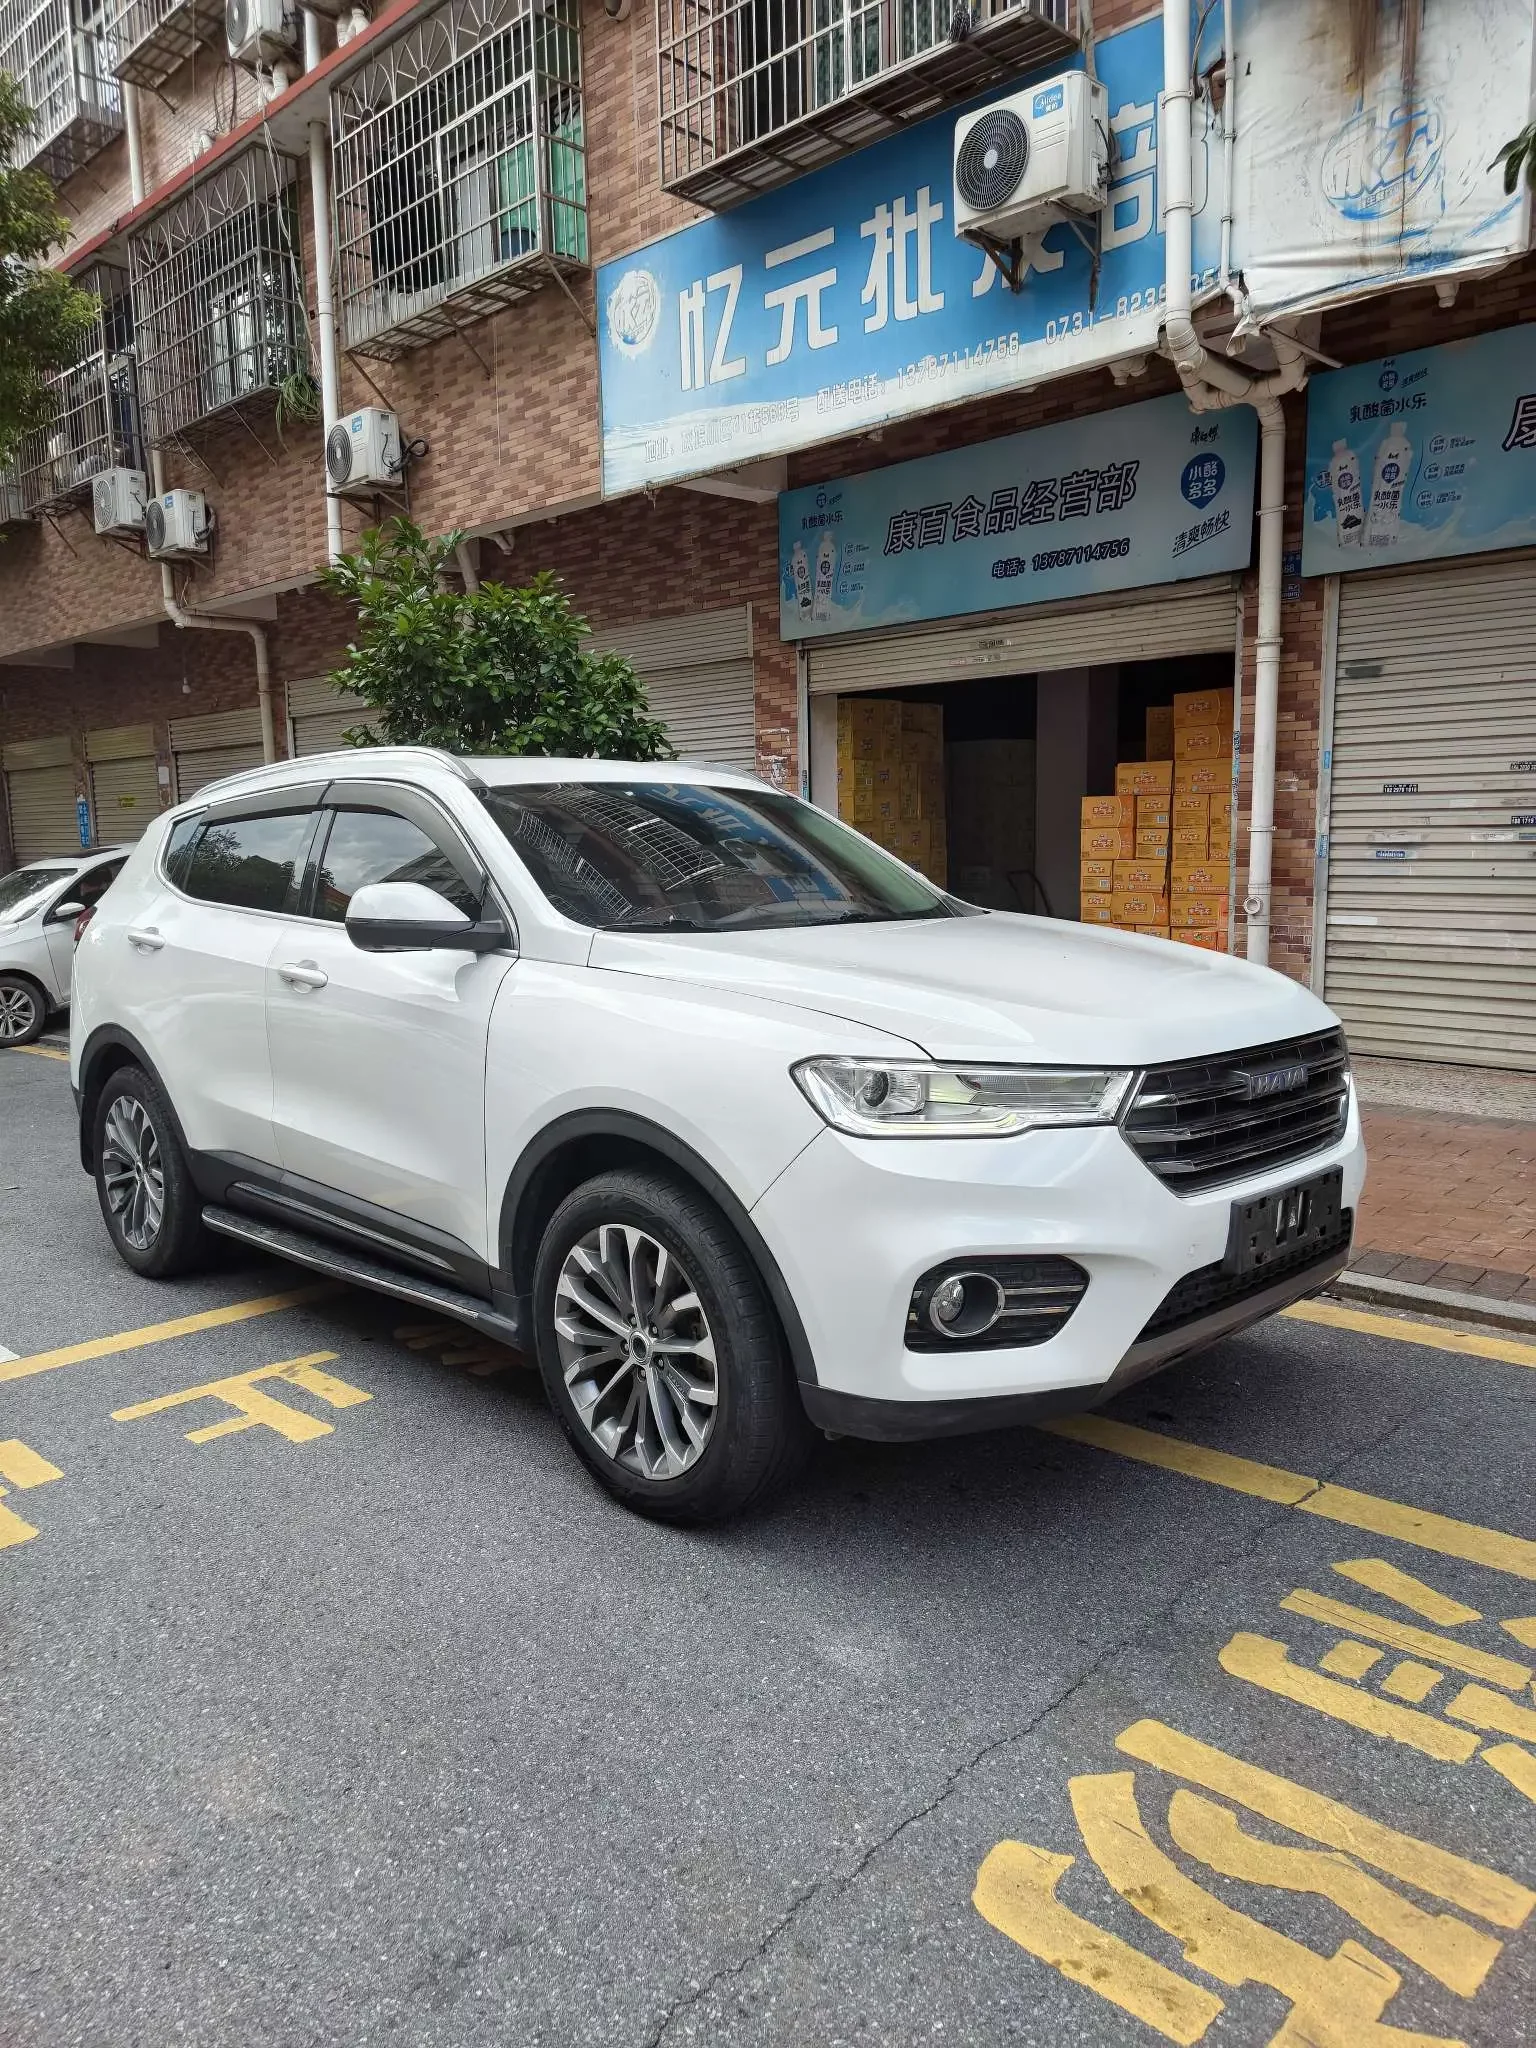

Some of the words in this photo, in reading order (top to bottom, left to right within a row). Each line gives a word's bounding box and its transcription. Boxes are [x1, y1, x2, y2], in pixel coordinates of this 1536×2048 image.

[678, 90, 1208, 393] 忆元批部
[884, 460, 1140, 555] 康百食品经营部
